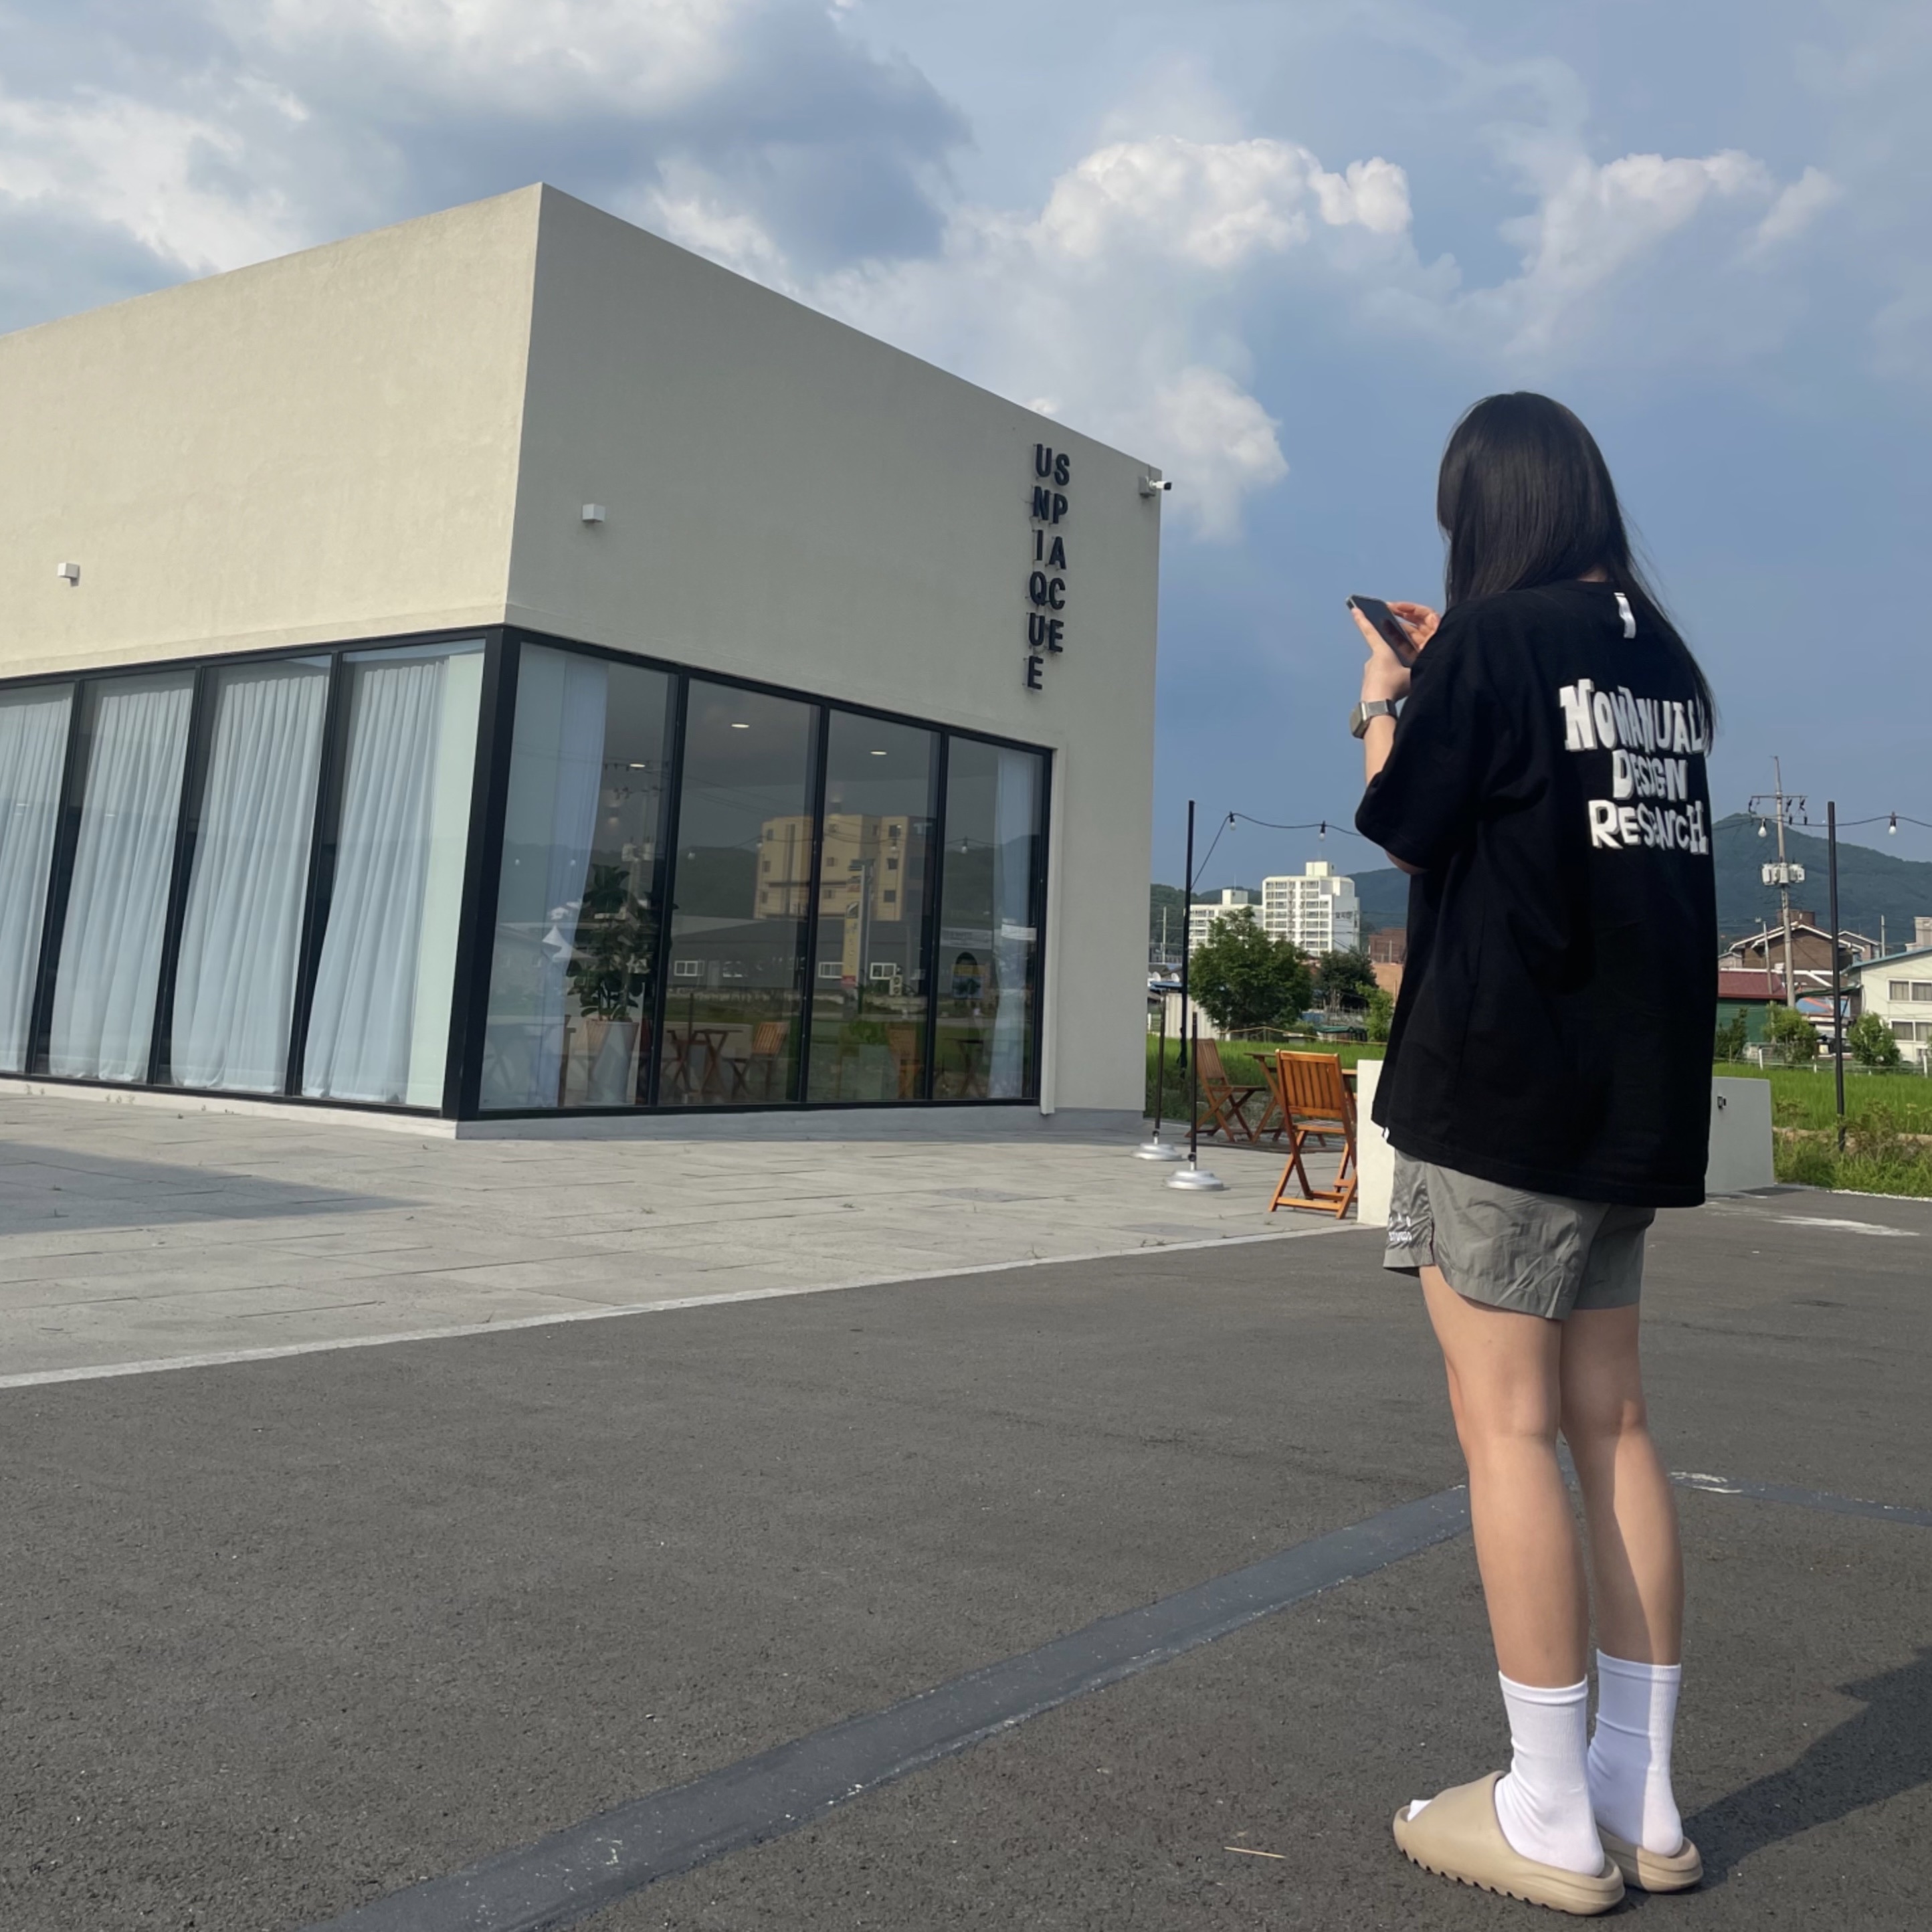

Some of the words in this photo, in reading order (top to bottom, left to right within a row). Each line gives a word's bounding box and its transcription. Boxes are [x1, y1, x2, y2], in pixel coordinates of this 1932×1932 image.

[1026, 444, 1052, 690] UNIQUE
[1048, 454, 1070, 653] SPACE
[1612, 749, 1687, 800] DESIGN
